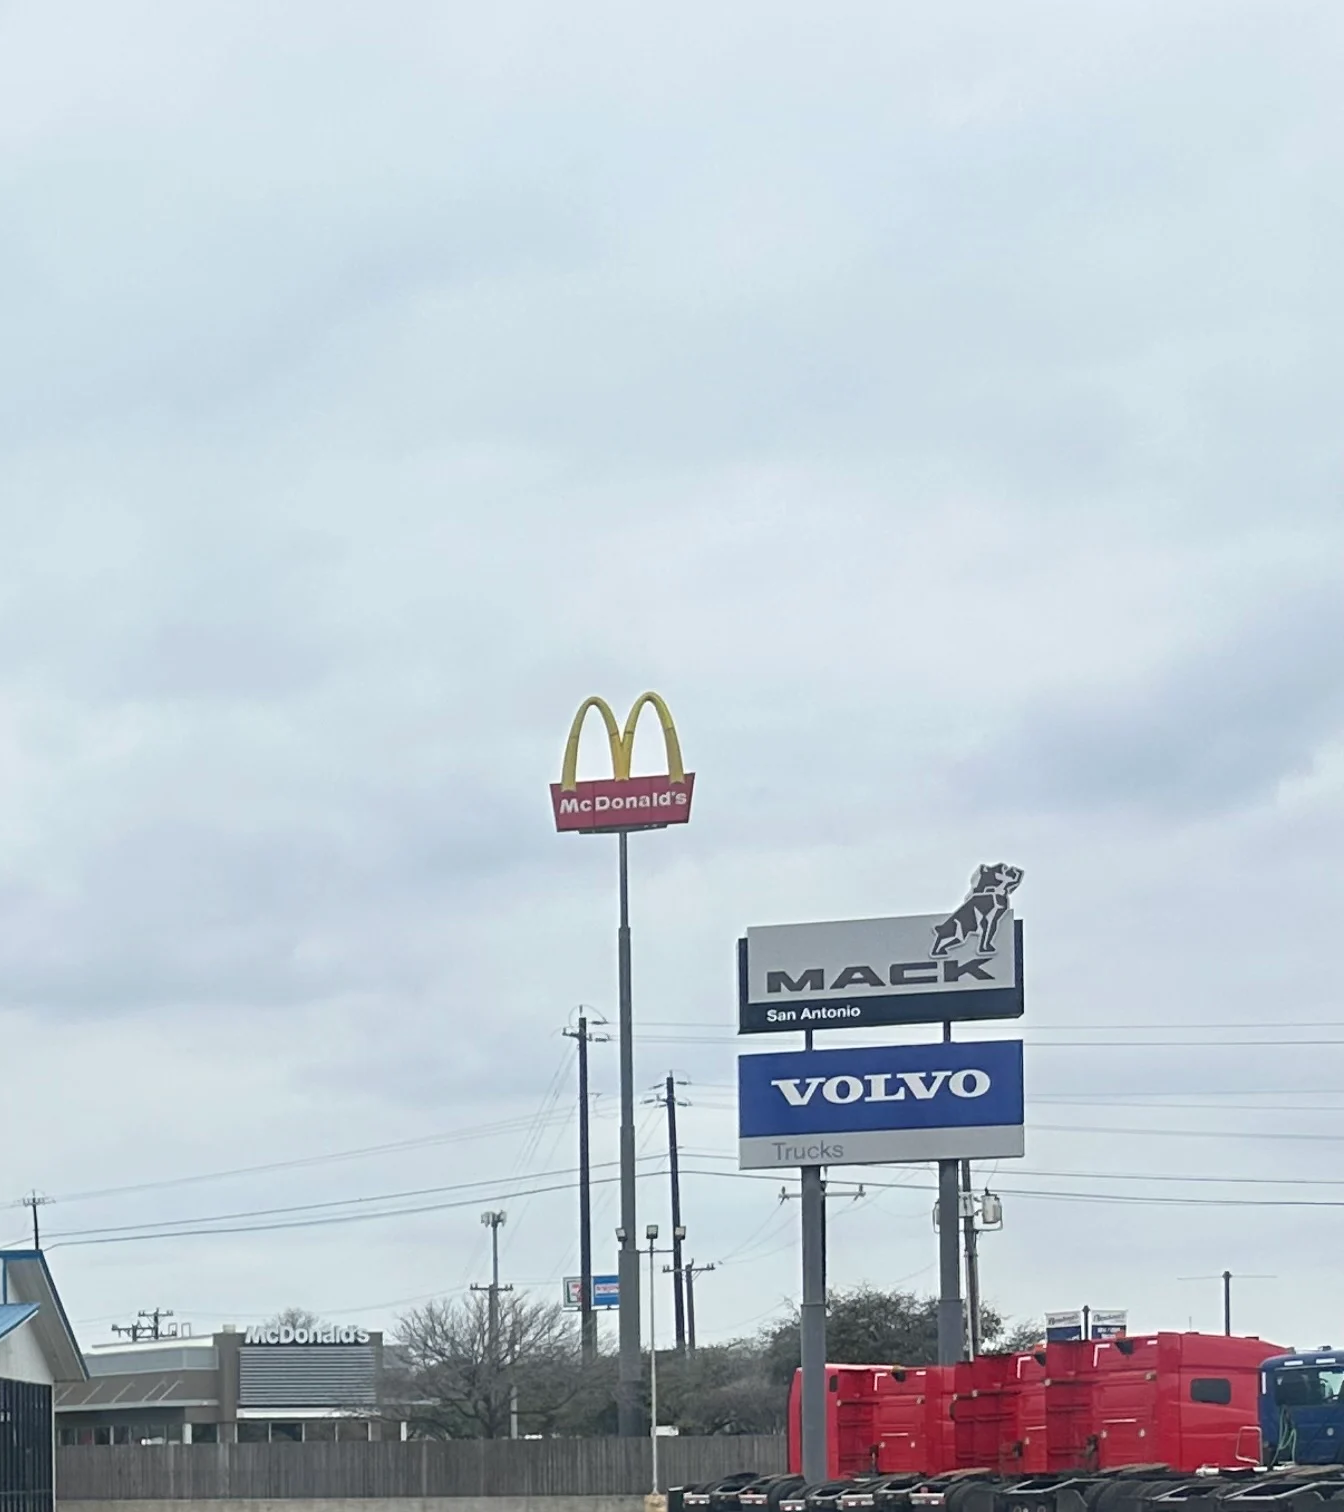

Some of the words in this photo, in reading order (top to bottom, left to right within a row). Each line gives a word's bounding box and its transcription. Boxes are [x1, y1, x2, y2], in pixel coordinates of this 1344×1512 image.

[559, 791, 687, 814] McDonald's
[767, 958, 996, 993] MACK
[766, 1009, 796, 1022] San
[800, 1005, 861, 1020] Antonio
[771, 1069, 991, 1106] VOLVO
[772, 1141, 845, 1161] Trucks
[245, 1325, 370, 1344] McDonald's
